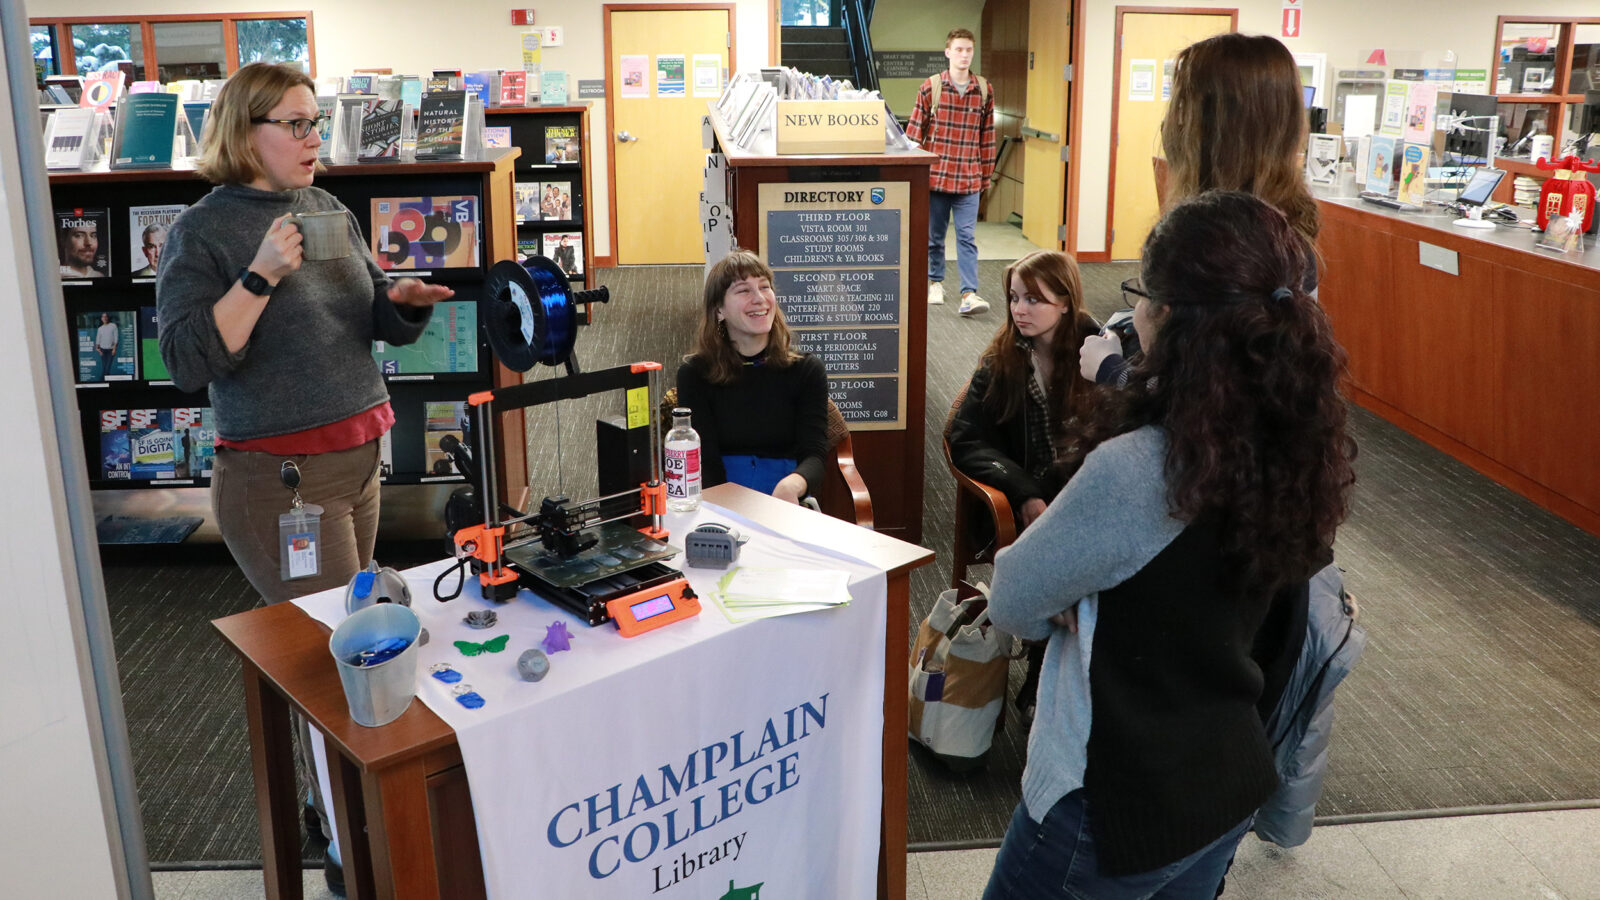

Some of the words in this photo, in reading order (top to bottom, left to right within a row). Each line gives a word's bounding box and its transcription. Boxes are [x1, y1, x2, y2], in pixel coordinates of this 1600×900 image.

[703, 117, 710, 126] A
[785, 114, 822, 126] NEW
[828, 114, 879, 126] BOOKS
[709, 156, 718, 168] N
[784, 191, 865, 203] DIRECTORY
[455, 200, 469, 223] VB
[797, 213, 832, 222] THIRD
[836, 213, 871, 221] FLOOR
[62, 218, 97, 229] Forbes
[709, 219, 718, 232] P
[800, 225, 825, 233] VISTA
[856, 224, 868, 232] 301
[779, 235, 834, 244] CLASSROOMS
[876, 234, 889, 242] 308
[804, 245, 833, 253] STUDY
[835, 244, 864, 252] ROOMS
[784, 255, 834, 263] CHILDREN'S
[857, 254, 884, 262] BOOKS
[793, 274, 836, 283] SECOND
[840, 273, 875, 281] FLOOR
[806, 285, 833, 293] SMART
[836, 284, 862, 292] SPACE
[788, 295, 802, 303] FOR
[846, 294, 882, 302] TEACHING
[787, 304, 838, 313] INTERFAITH
[840, 304, 865, 312] ROOM
[868, 304, 881, 312] 220
[827, 314, 833, 322] &
[835, 314, 863, 322] STUDY
[865, 313, 894, 321] ROOMS
[800, 333, 829, 341] FIRST
[824, 343, 877, 351] PERIODICALS
[824, 353, 859, 361] PRINTER
[841, 381, 875, 389] FLOOR
[102, 409, 128, 428] SF
[130, 409, 158, 428] SF
[174, 408, 202, 428] SF
[873, 410, 888, 418] G08
[138, 443, 173, 455] DIGITA
[547, 692, 829, 848] CHAMPLAIN
[588, 752, 801, 879] COLLEGE
[652, 831, 748, 894] Library
